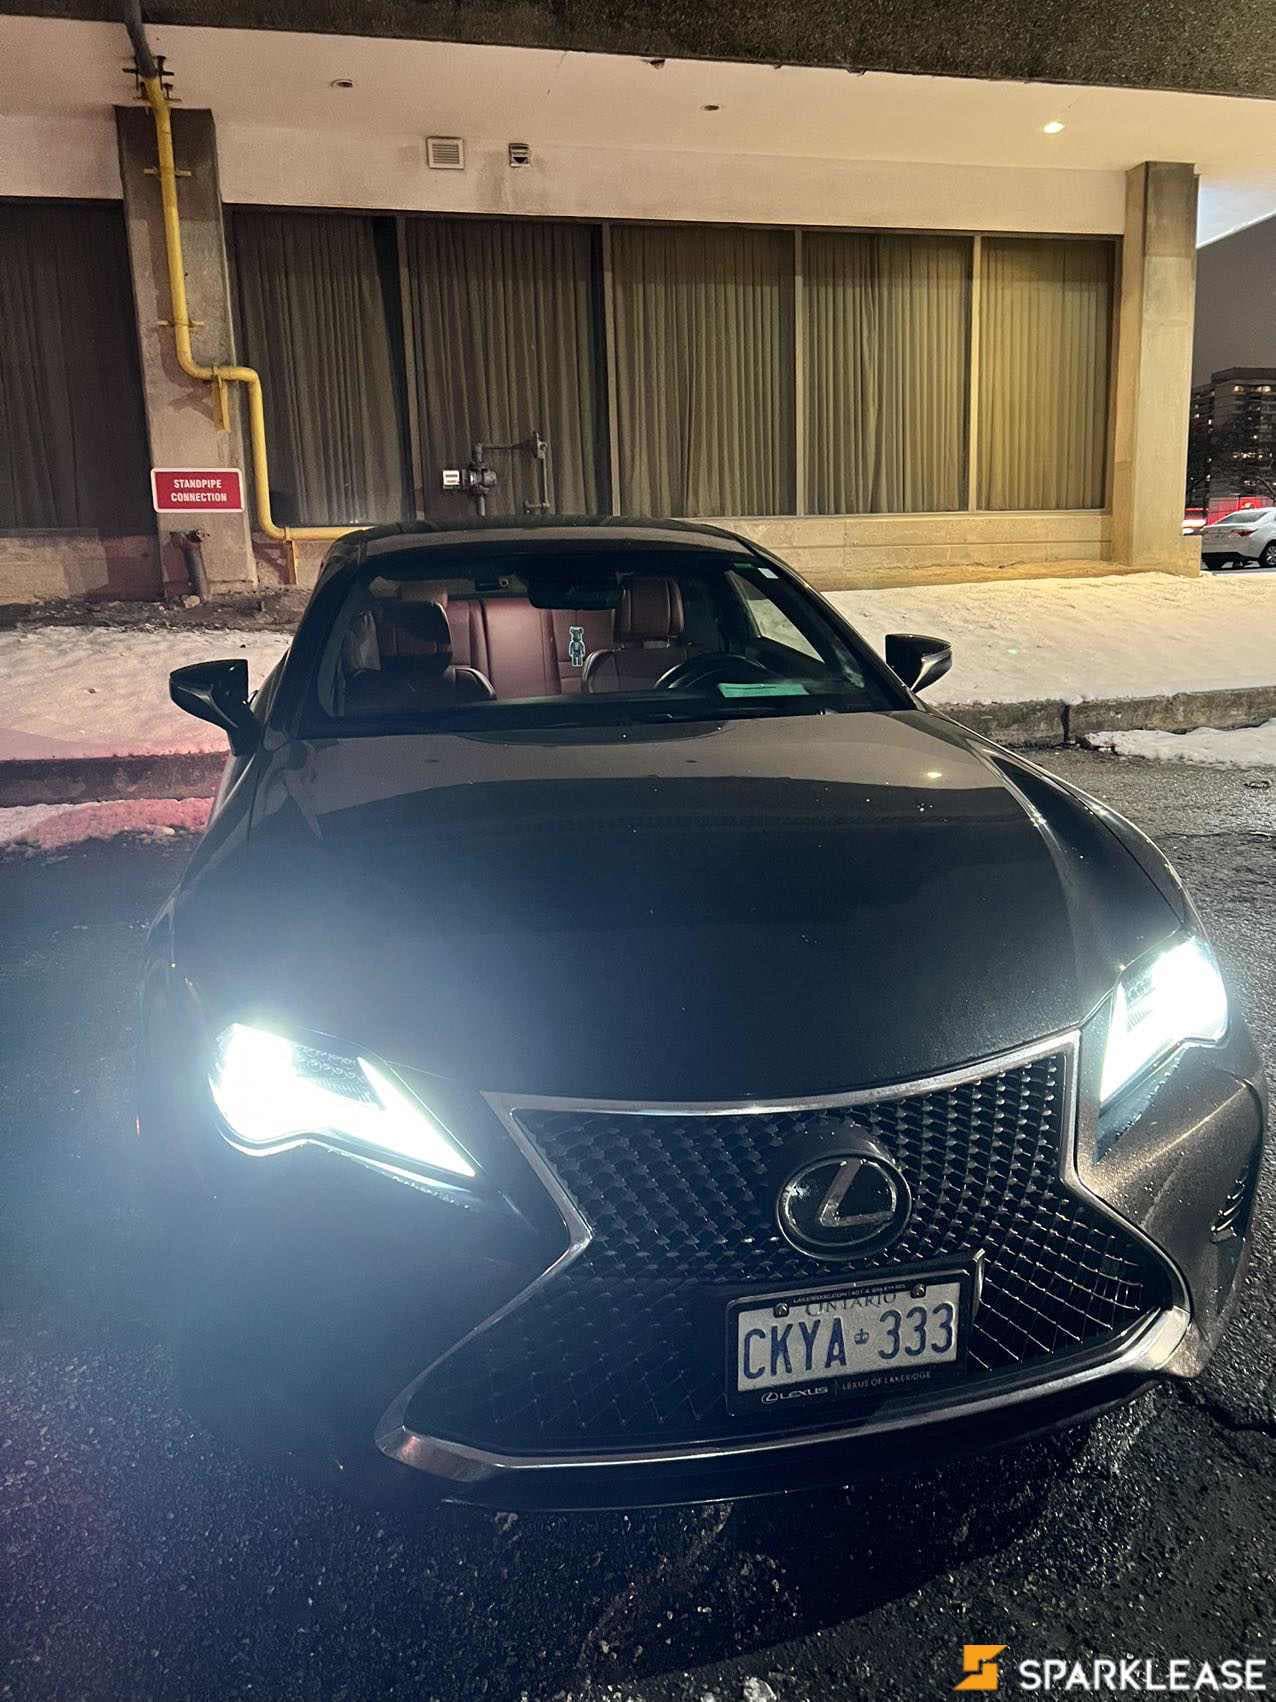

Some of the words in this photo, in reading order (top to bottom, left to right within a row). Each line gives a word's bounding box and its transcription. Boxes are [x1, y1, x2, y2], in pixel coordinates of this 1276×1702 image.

[173, 479, 222, 489] STANDPIPE
[170, 492, 227, 502] CONNECTION
[743, 1317, 847, 1380] CKYA
[878, 1303, 955, 1360] 333
[779, 1386, 829, 1400] LEXUS
